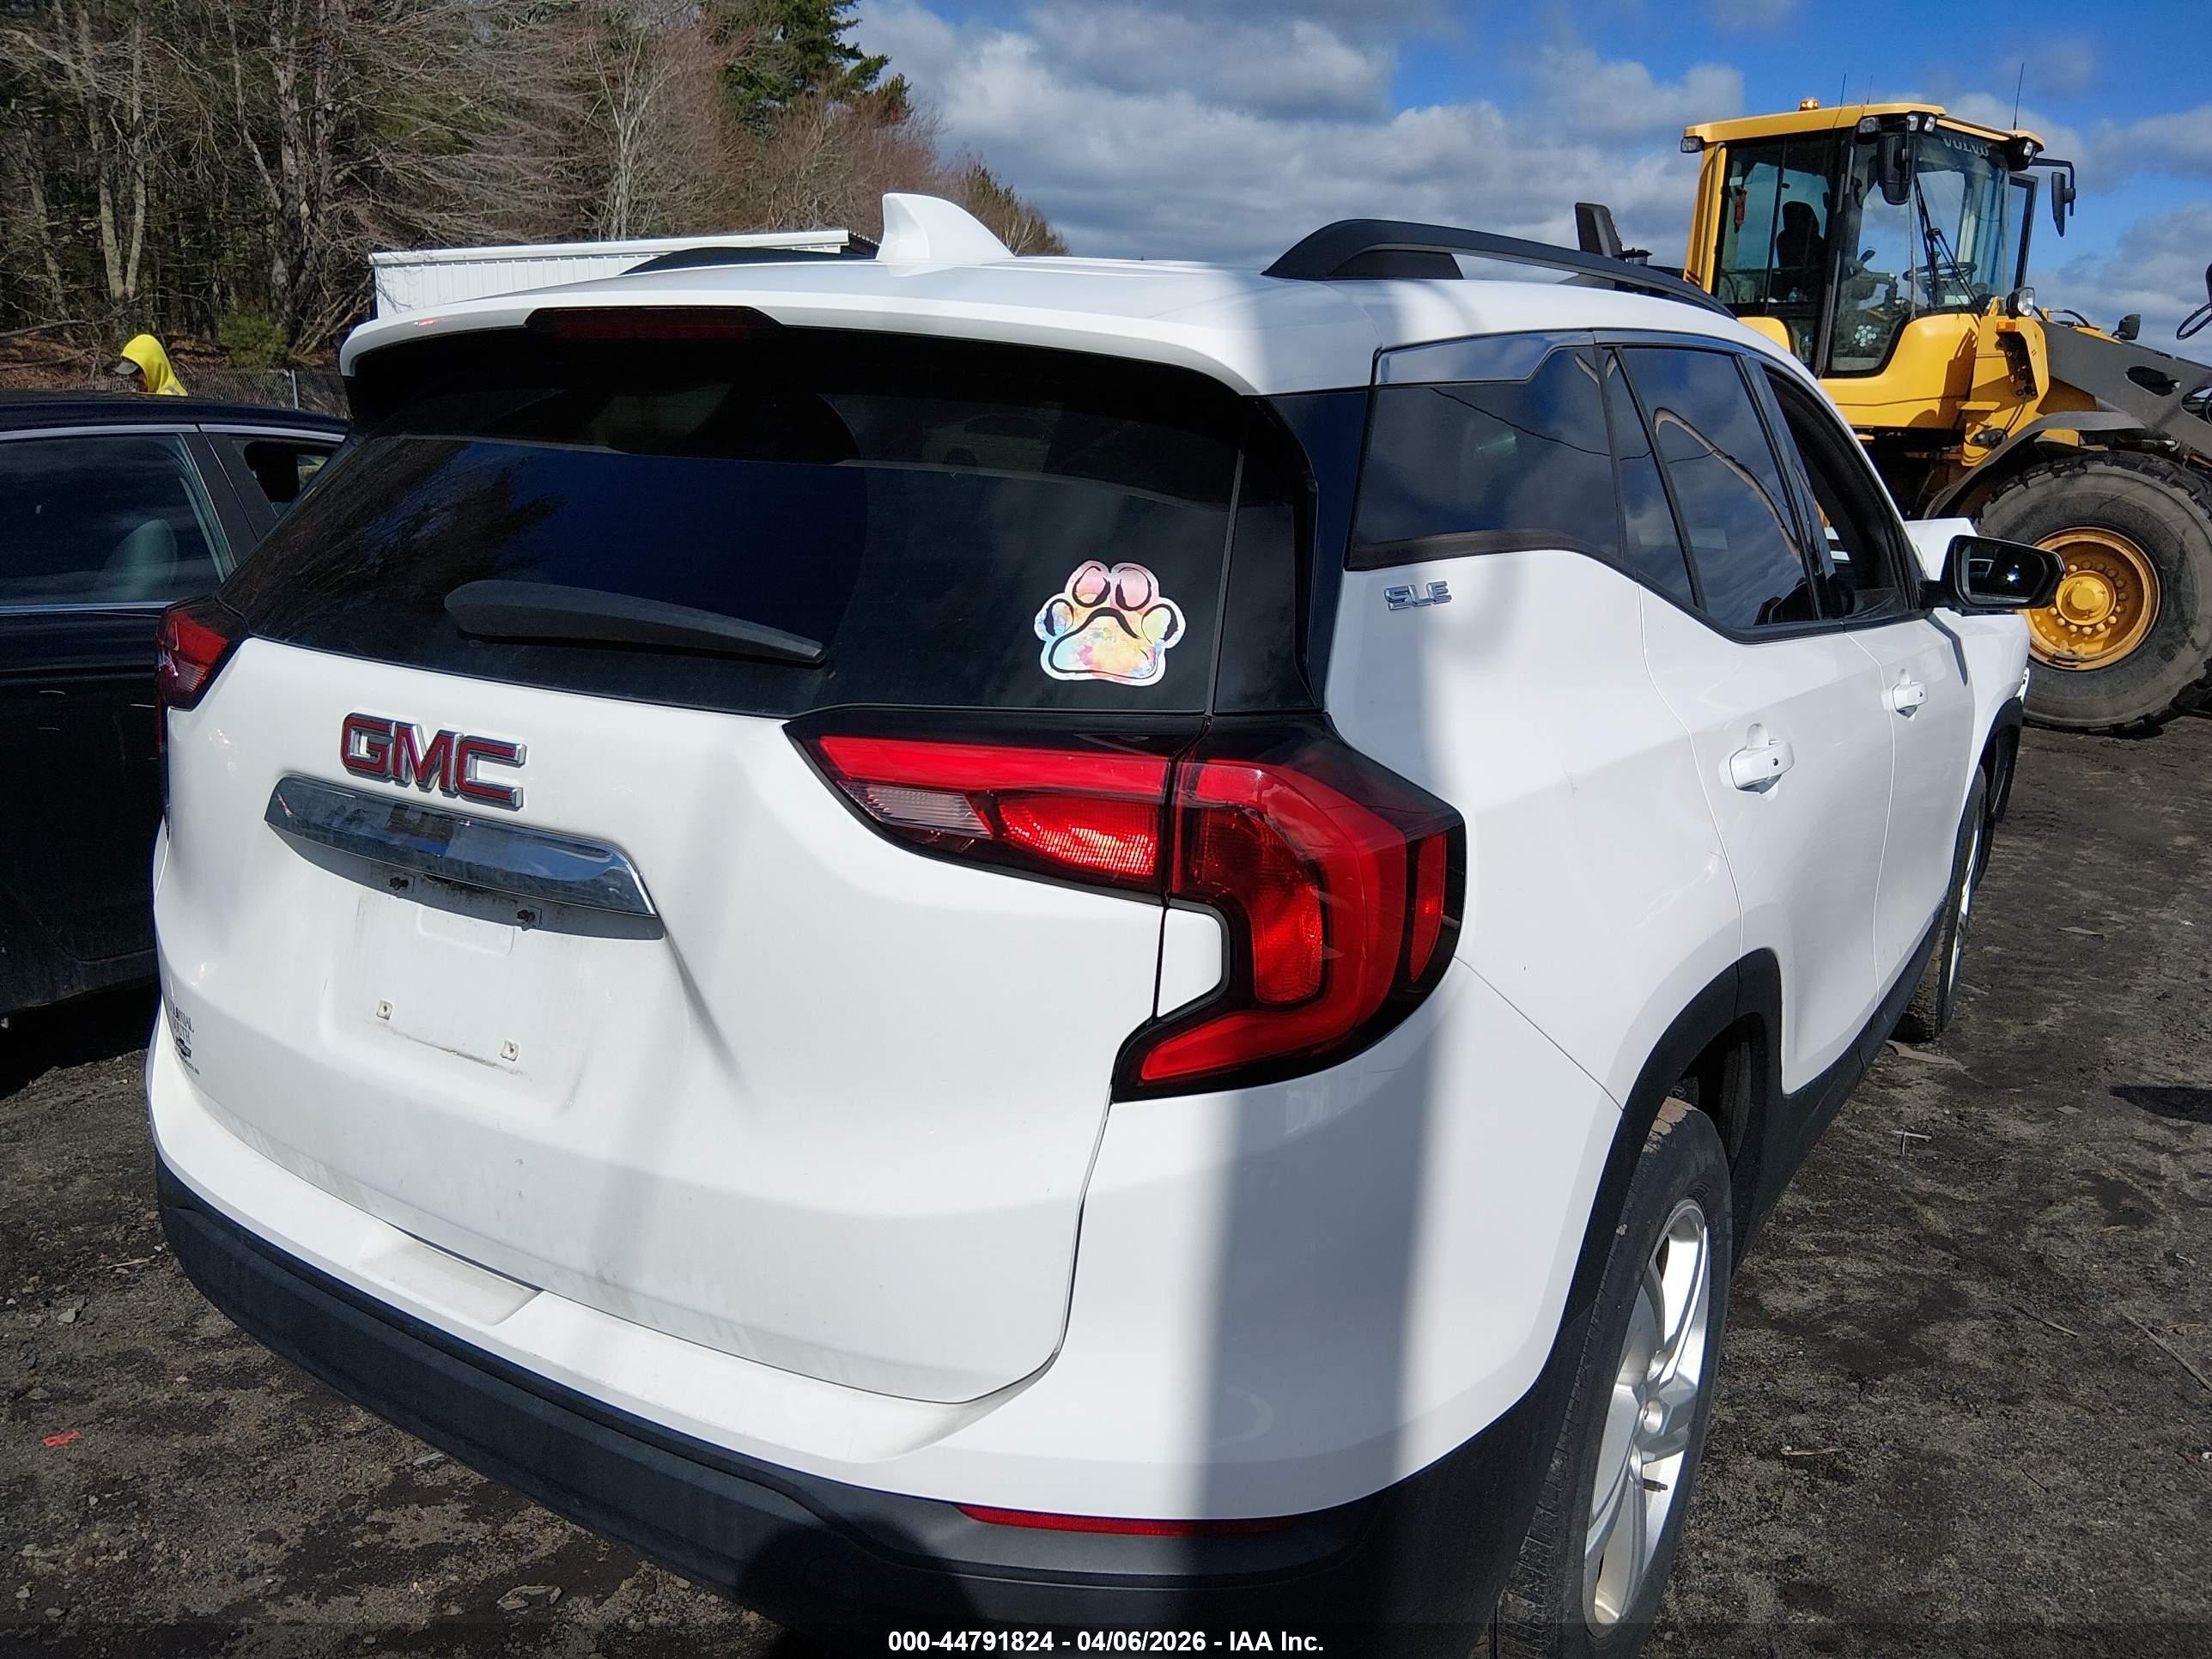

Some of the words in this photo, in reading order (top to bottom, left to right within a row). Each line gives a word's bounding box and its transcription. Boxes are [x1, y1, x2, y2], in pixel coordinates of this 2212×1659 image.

[1942, 137, 1990, 157] VOLVO
[1383, 580, 1453, 611] SLE
[341, 712, 527, 811] GMC
